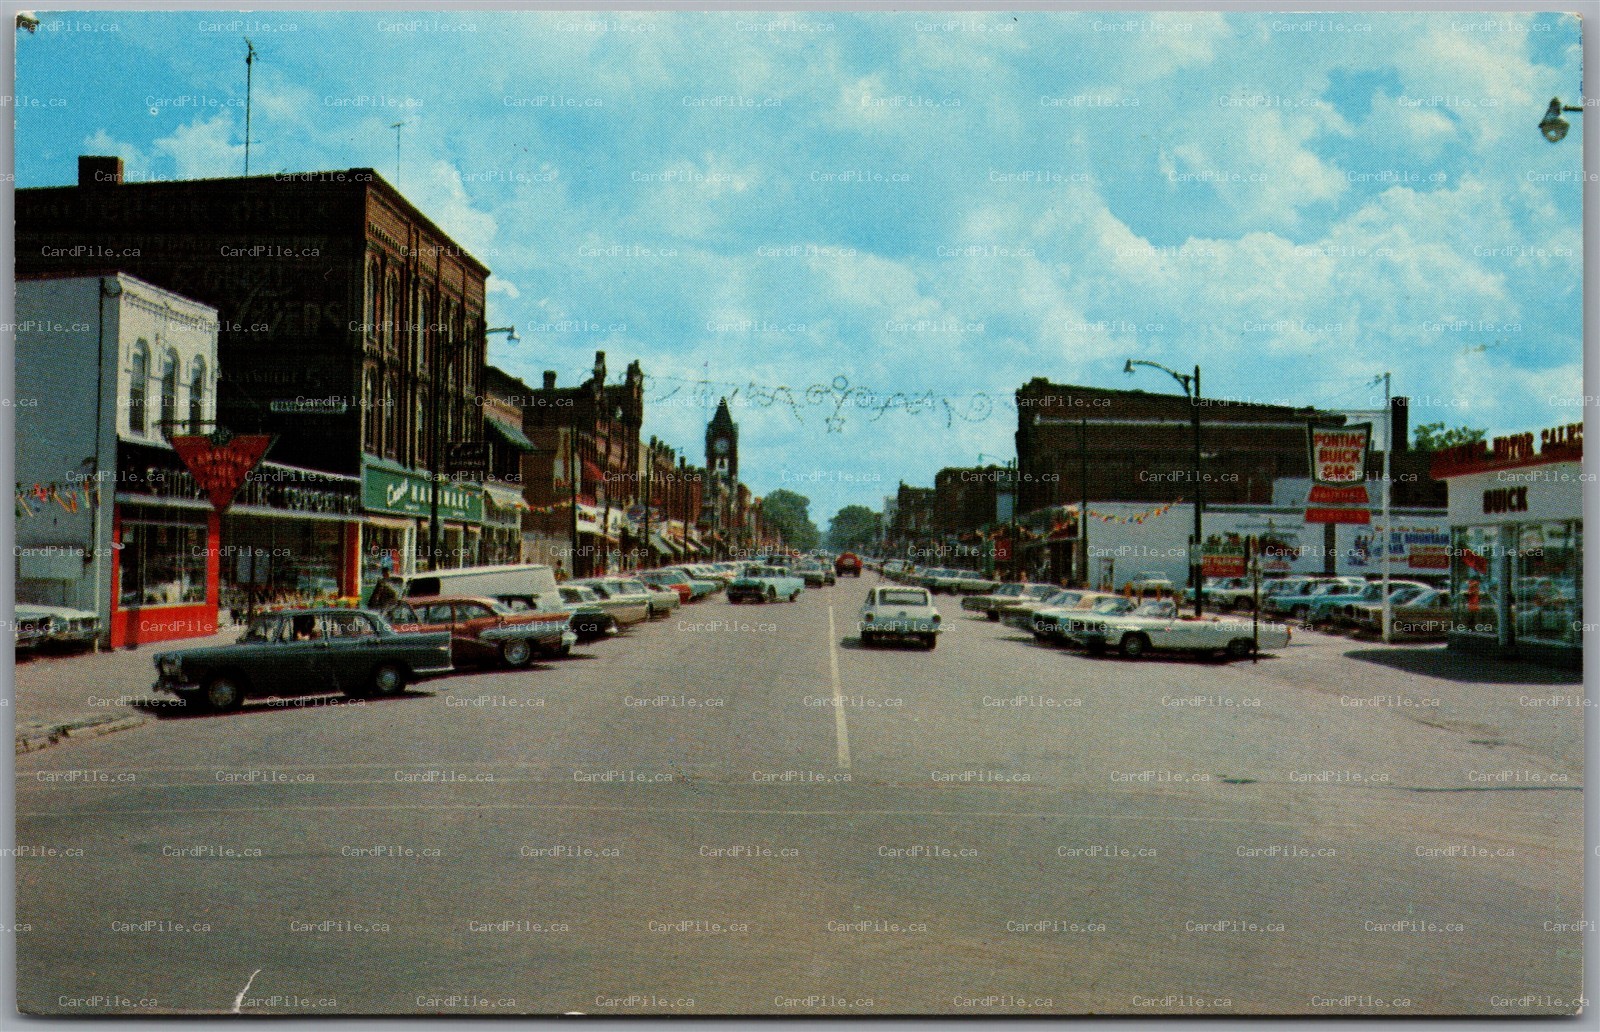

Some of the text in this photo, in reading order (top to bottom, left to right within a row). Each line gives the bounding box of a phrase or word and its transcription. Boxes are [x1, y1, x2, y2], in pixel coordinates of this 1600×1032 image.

[1313, 432, 1366, 448] PONTIAC
[1493, 432, 1534, 459] MOTOR
[188, 450, 252, 468] CANADIAN
[1319, 448, 1361, 463] BUICK
[206, 464, 234, 477] TIRE
[1483, 486, 1528, 514] BUICK
